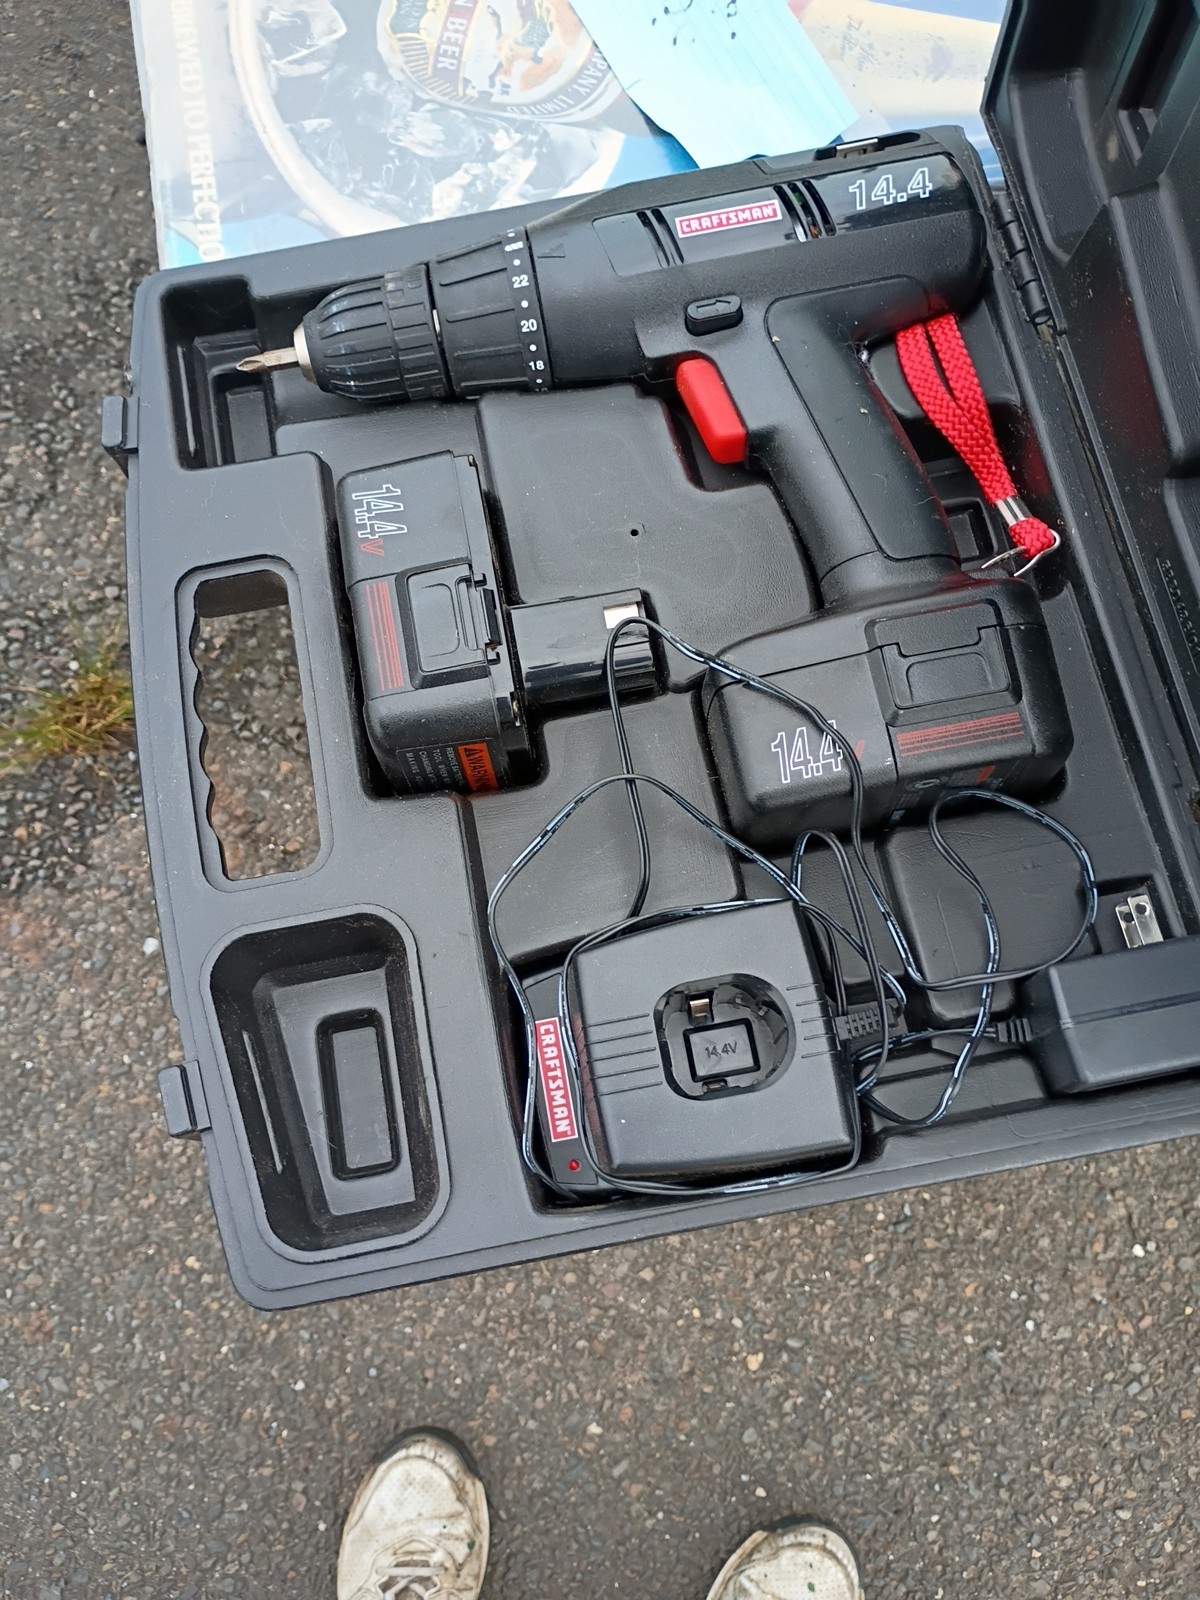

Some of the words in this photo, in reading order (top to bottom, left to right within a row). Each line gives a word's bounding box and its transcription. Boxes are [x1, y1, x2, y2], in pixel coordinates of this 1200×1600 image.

[170, 0, 205, 93] BREWED
[436, 17, 468, 73] BEER
[180, 95, 210, 129] TO
[506, 95, 575, 115] LIMITED
[186, 133, 224, 261] PERFECTIO
[848, 167, 933, 211] 14.4
[681, 205, 775, 232] CRAFTSMAN
[512, 274, 529, 289] 22
[520, 318, 538, 333] 20
[528, 360, 545, 371] 18
[704, 1041, 738, 1059] 14.4V
[538, 1024, 571, 1137] CRAFTSMAN
